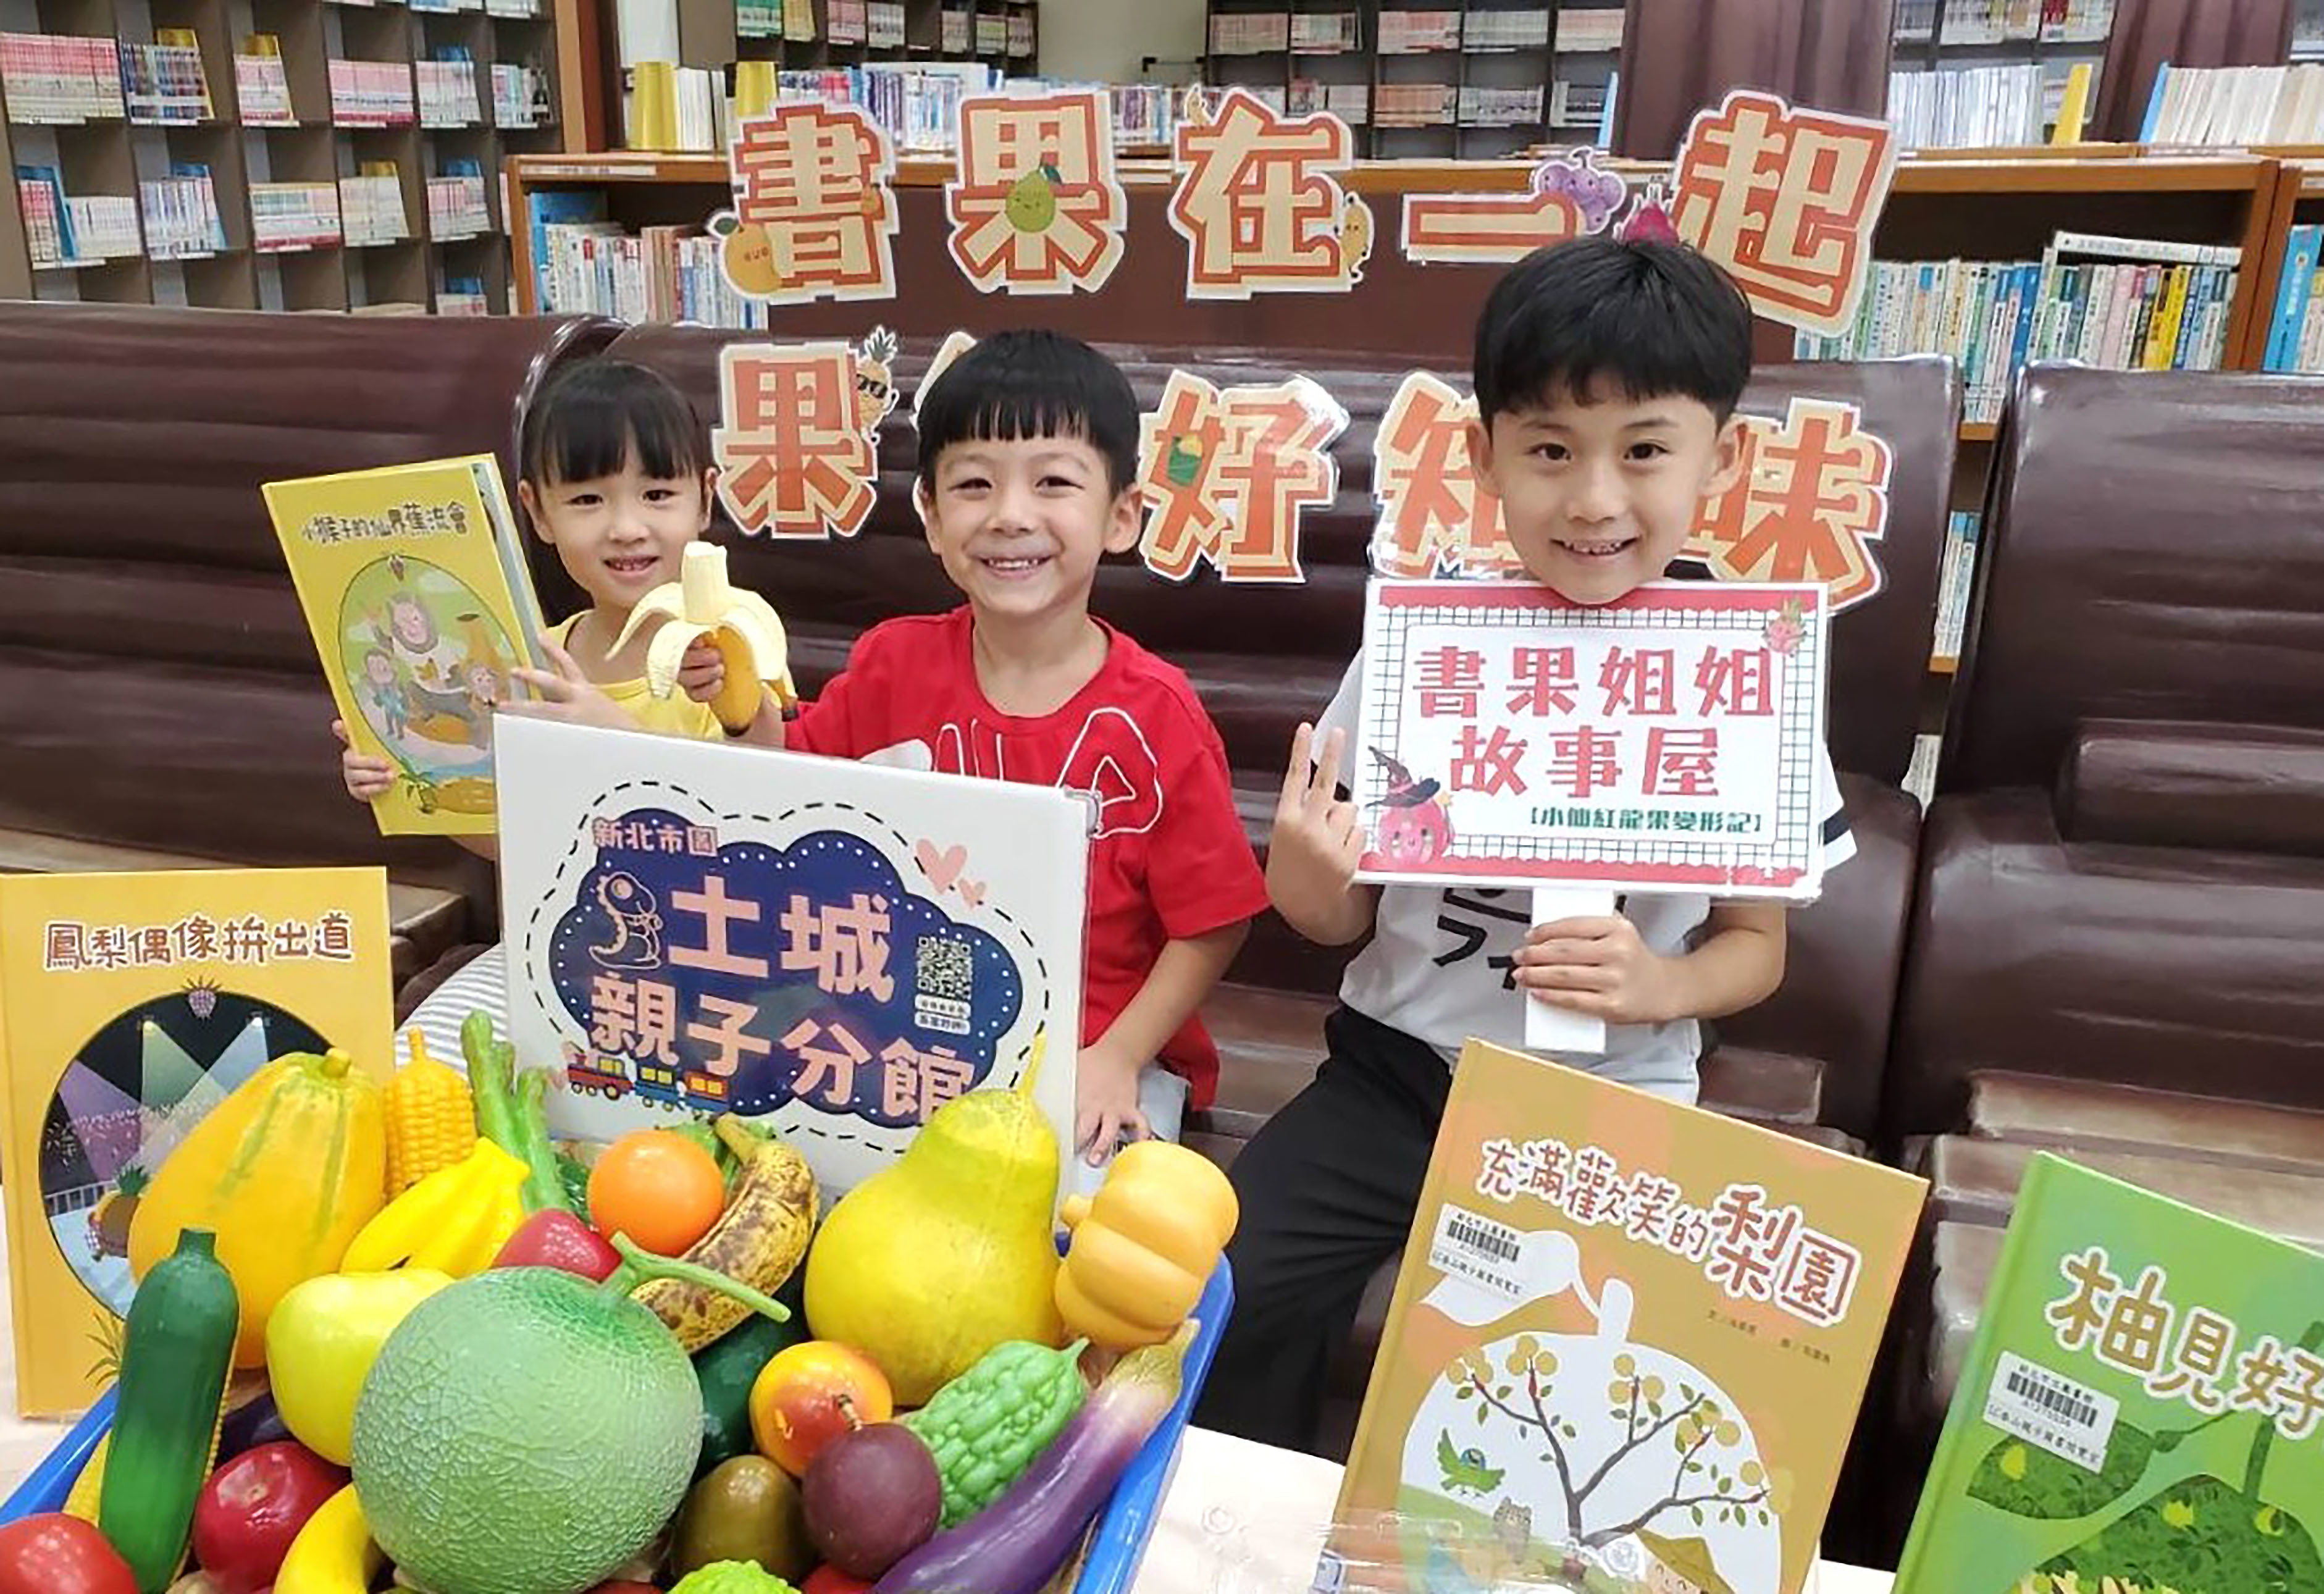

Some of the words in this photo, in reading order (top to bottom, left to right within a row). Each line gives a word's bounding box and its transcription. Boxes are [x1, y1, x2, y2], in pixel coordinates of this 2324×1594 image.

[731, 90, 1897, 338] 書果在一起
[1412, 645, 1775, 718] 書果姐姐
[1449, 724, 1720, 799] 故事屋
[668, 875, 895, 1004] 土城
[588, 970, 976, 1125] 親子分館
[1478, 1139, 1859, 1327] 充滿歡笑的梨園
